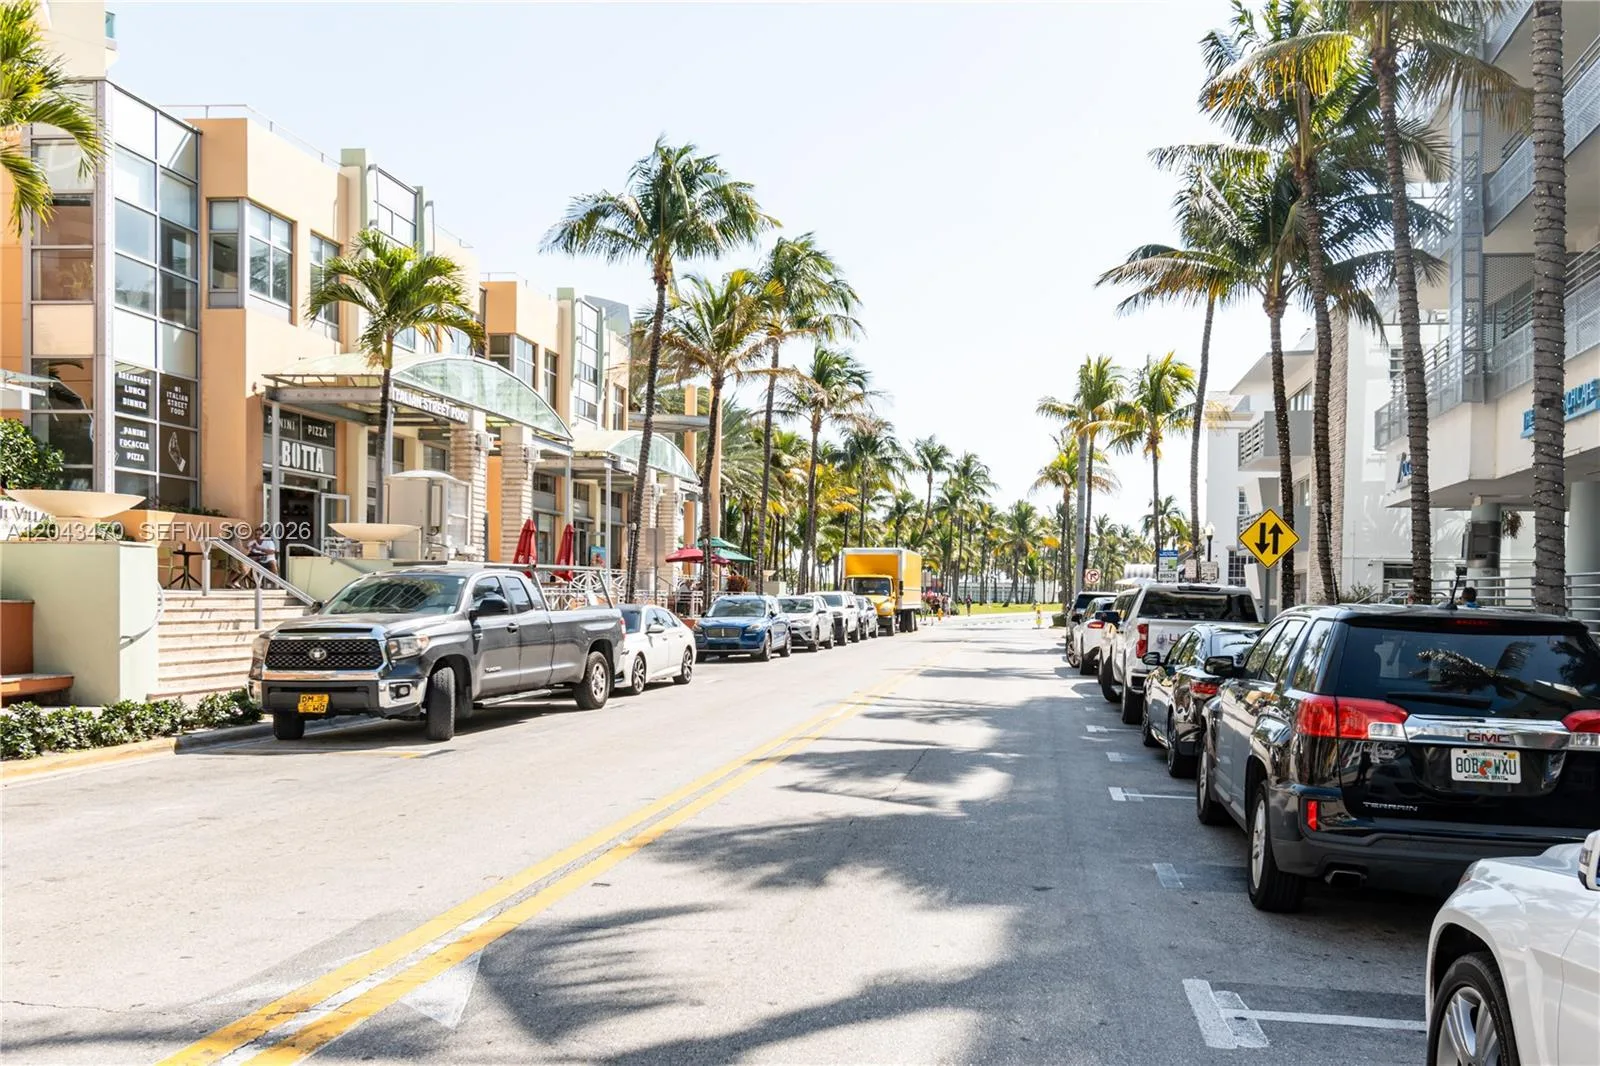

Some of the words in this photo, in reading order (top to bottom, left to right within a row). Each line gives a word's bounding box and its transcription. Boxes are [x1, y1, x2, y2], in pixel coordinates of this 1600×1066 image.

[124, 385, 146, 396] LUNCH
[166, 391, 189, 402] ITALIAN
[122, 397, 147, 409] DINNER
[167, 399, 188, 409] STREET
[170, 407, 185, 416] FOOD
[123, 426, 146, 437] PANINI
[268, 415, 295, 431] PNINI
[307, 424, 328, 438] PIZZA
[119, 438, 150, 450] FOCACCIA
[126, 452, 145, 462] PIZZA
[281, 440, 324, 472] BOTTA
[14, 505, 50, 523] VILLA
[1202, 572, 1216, 581] 25
[1467, 732, 1510, 744] GMC
[1493, 758, 1517, 775] WXU
